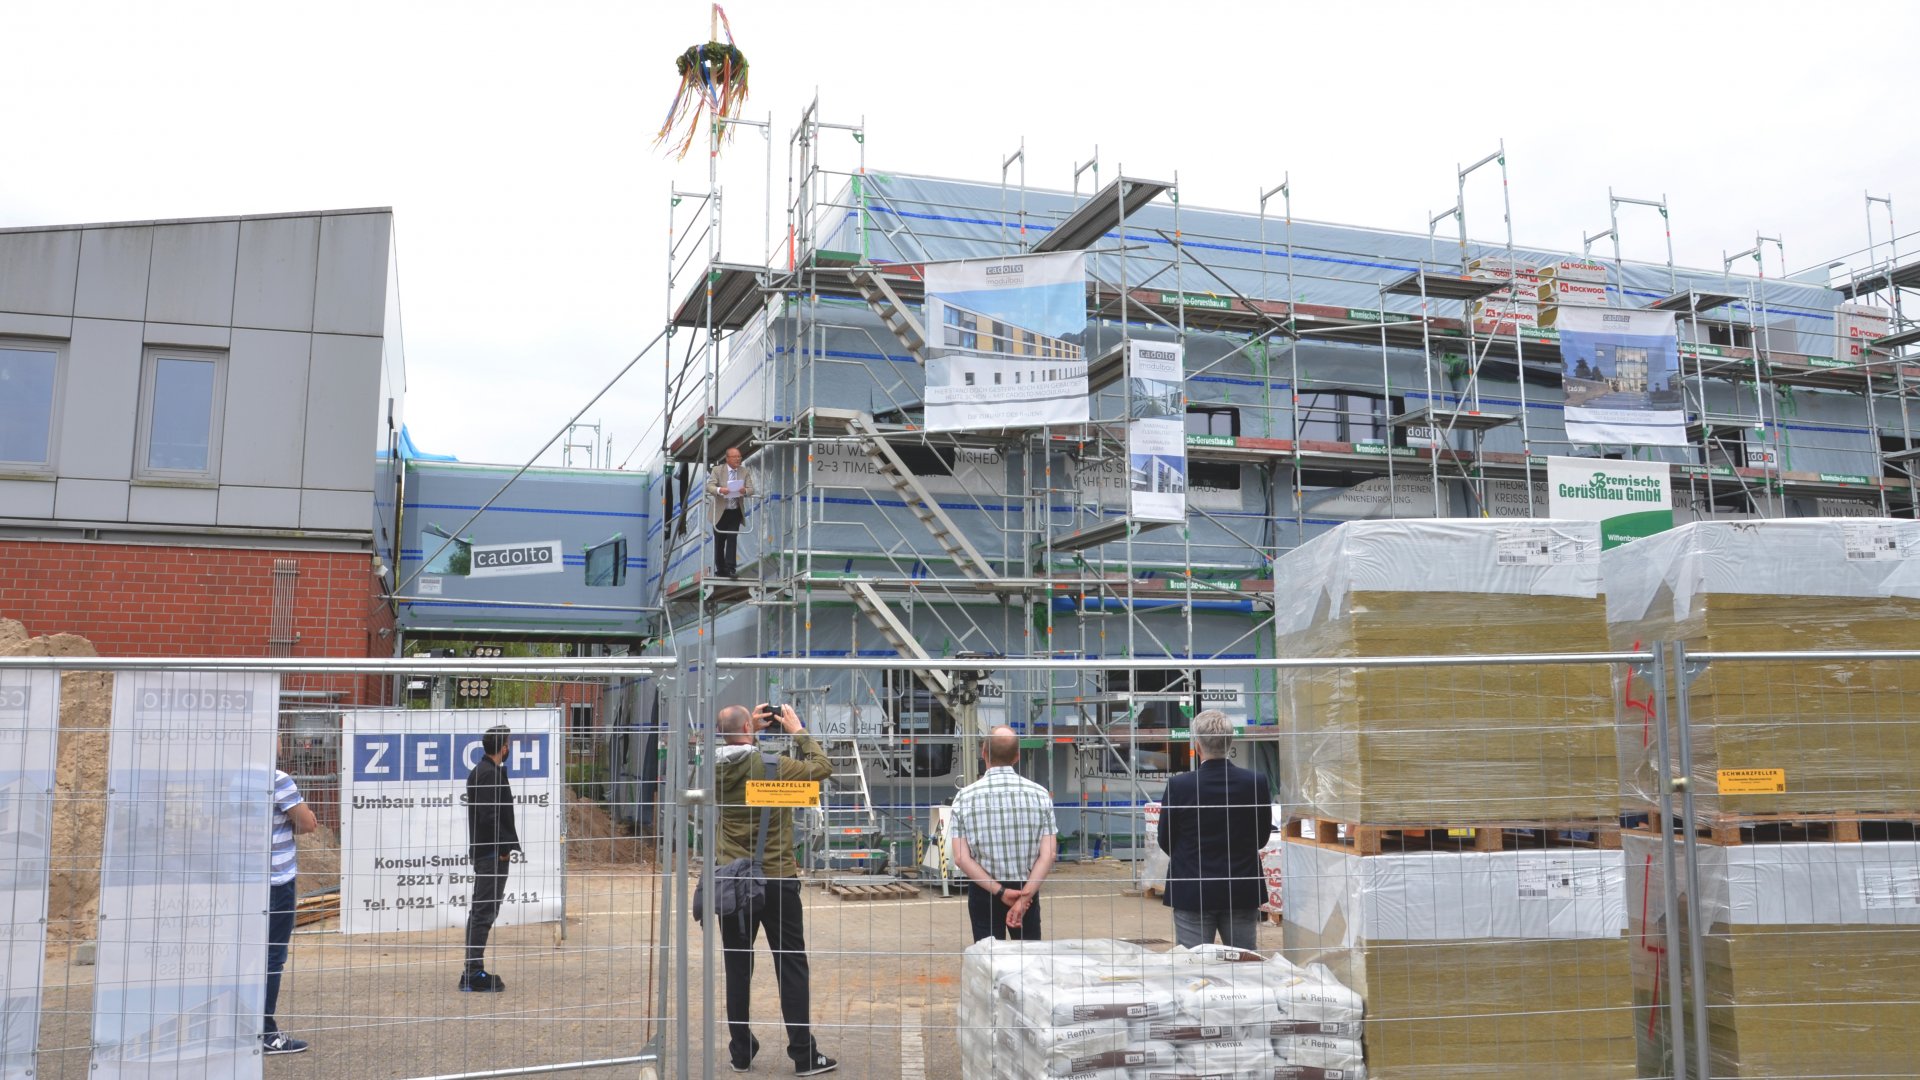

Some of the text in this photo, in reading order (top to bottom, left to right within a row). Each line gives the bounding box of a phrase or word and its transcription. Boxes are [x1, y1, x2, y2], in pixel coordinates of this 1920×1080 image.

[1571, 262, 1606, 271] ROCKWOOL
[1570, 286, 1605, 294] ROCKWOOL
[1140, 350, 1175, 360] cadolto
[817, 444, 842, 456] BUT
[1589, 472, 1661, 489] Bremische
[1559, 483, 1662, 502] Gerüstbau GmbH
[477, 547, 550, 566] cadolto
[353, 791, 550, 810] Umbau und Srung
[397, 873, 475, 887] 28217 Bre
[363, 899, 390, 911] Tel.
[396, 897, 434, 910] 0421
[522, 891, 540, 904] 11
[1310, 994, 1338, 1003] Remix
[1067, 1027, 1096, 1039] Remix
[1311, 1040, 1337, 1049] Remix
